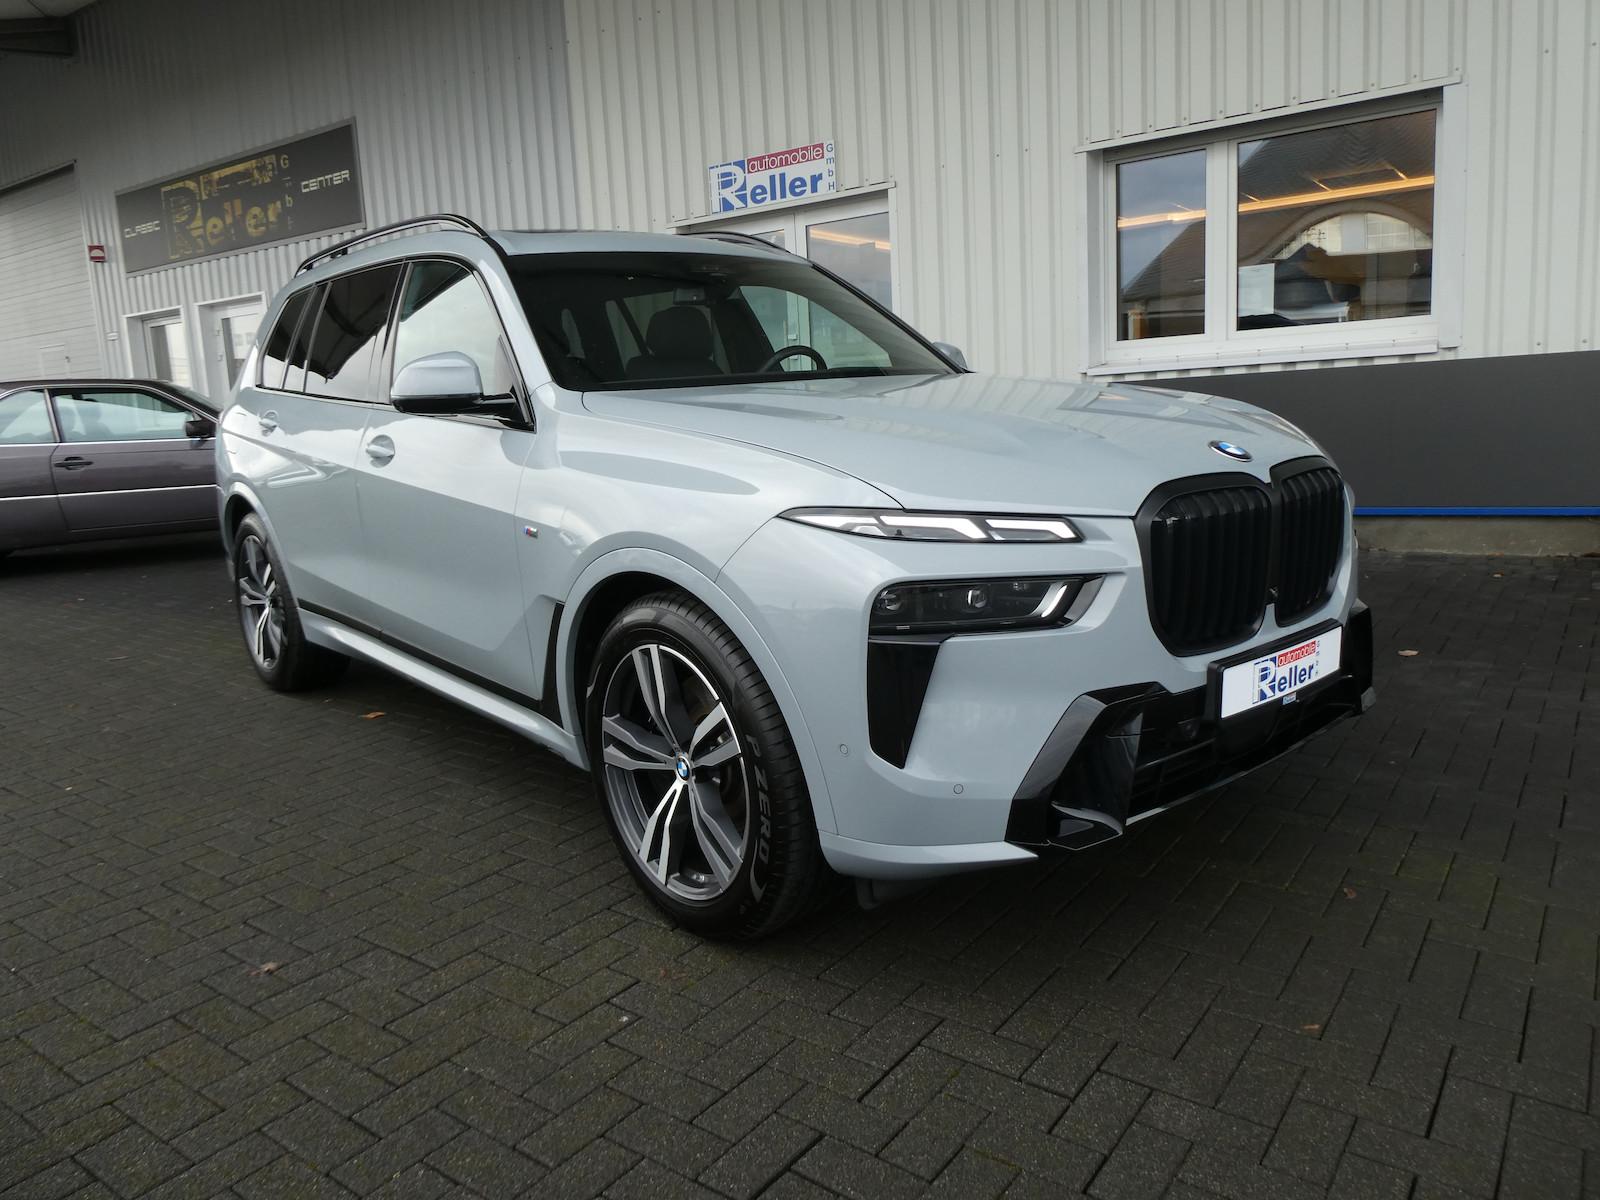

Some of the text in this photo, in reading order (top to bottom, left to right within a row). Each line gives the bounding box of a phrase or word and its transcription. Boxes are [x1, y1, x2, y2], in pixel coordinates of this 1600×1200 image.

[301, 169, 351, 193] CENTER
[748, 145, 823, 173] automobile
[825, 143, 835, 191] GmbH
[709, 164, 823, 214] Reller
[1252, 659, 1315, 704] Reller
[754, 764, 772, 865] ZERO
